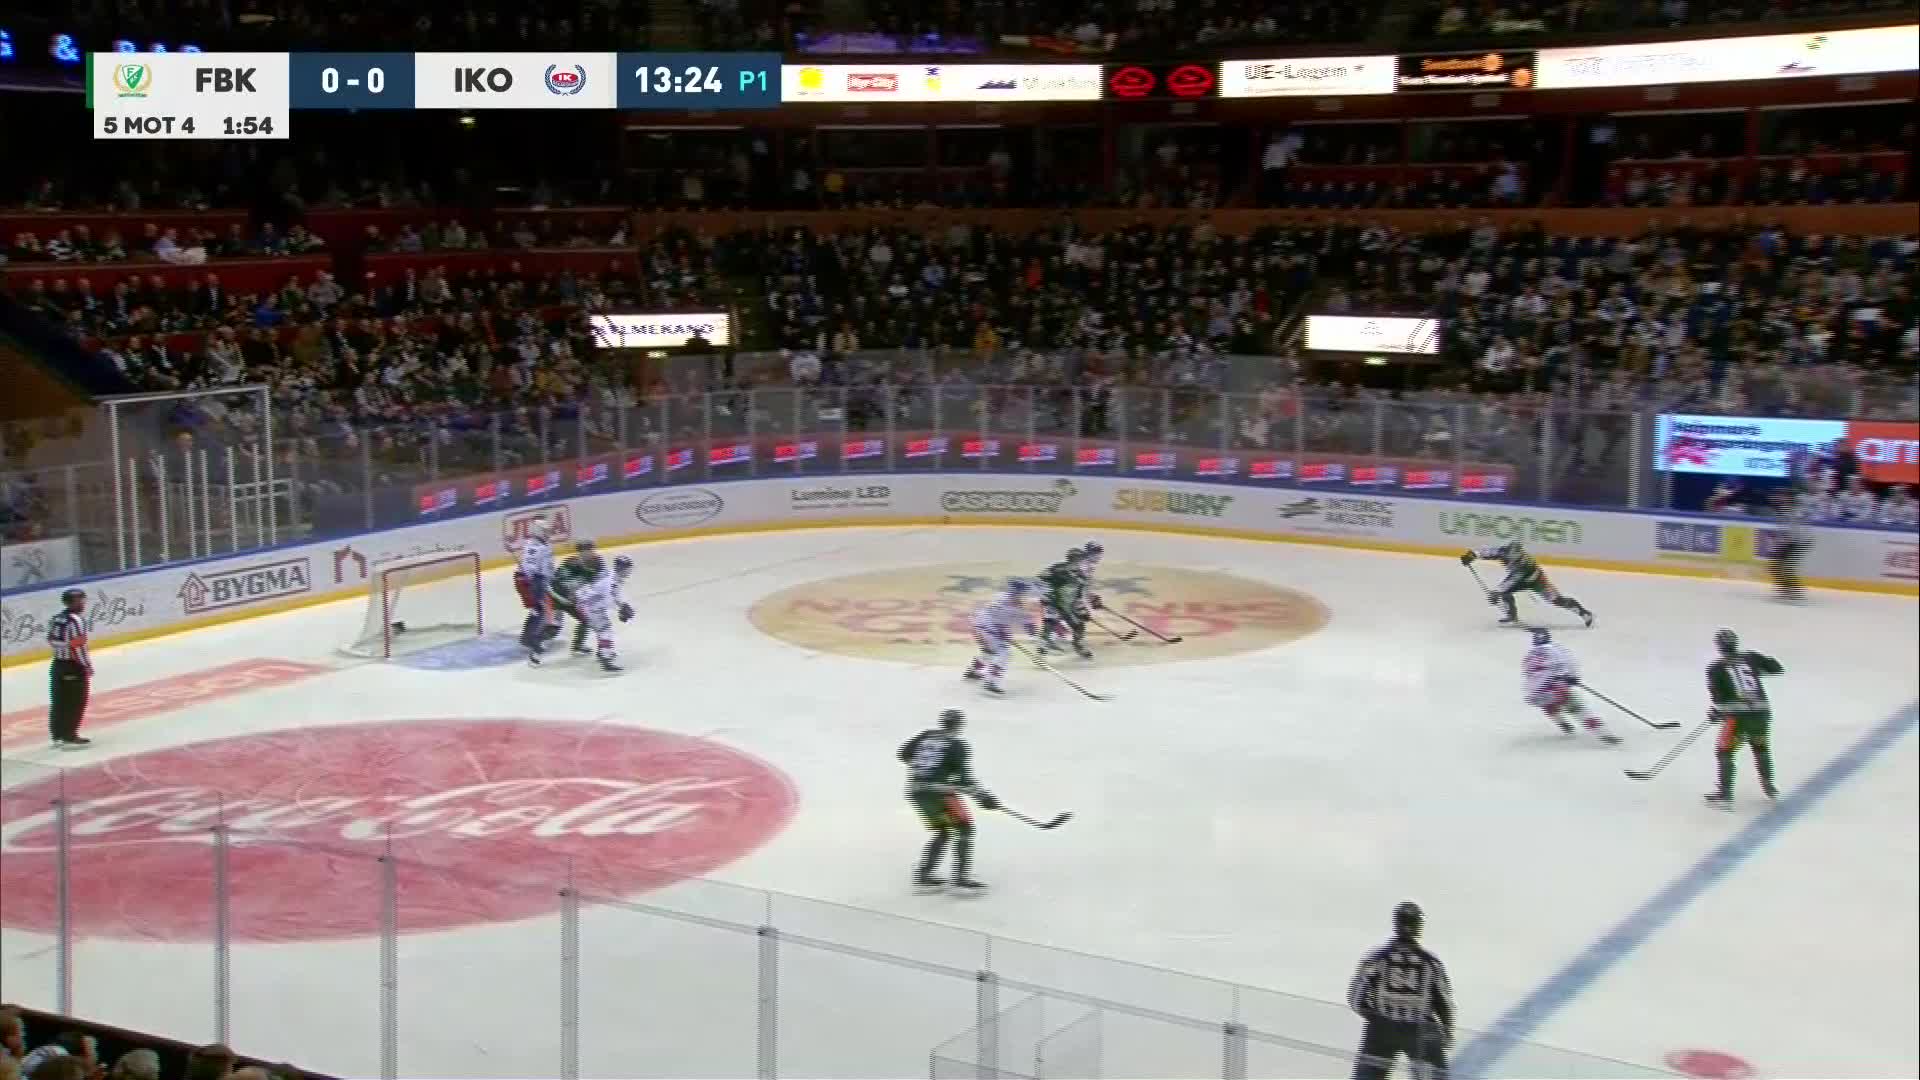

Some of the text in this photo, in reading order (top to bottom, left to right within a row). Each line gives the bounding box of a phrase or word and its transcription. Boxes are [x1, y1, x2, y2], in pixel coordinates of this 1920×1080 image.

[791, 485, 890, 501] Lumino LED
[941, 491, 1063, 512] CASHBUDDY
[1112, 489, 1233, 516] SUBWAY
[1325, 498, 1395, 514] INTEROC
[1325, 512, 1395, 529] AKUSTIK
[212, 566, 307, 601] BYGMA
[1725, 662, 1759, 692] 16
